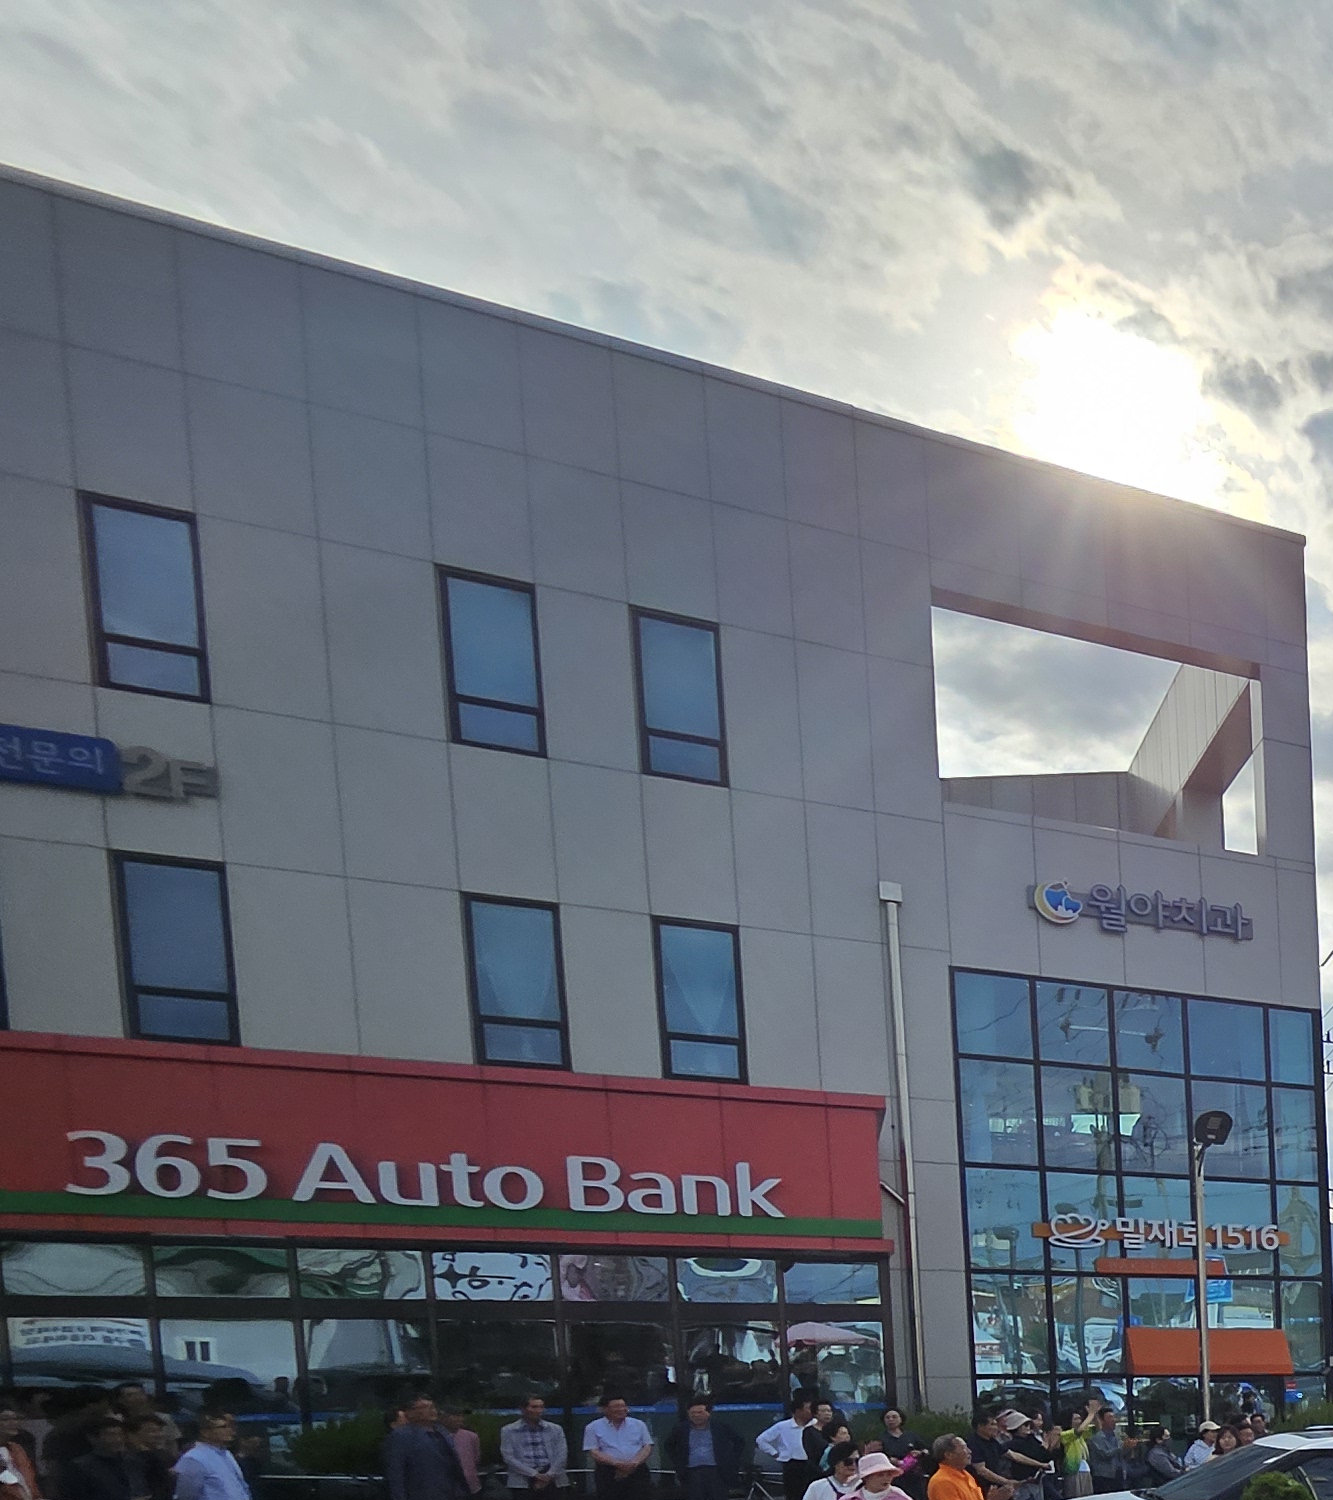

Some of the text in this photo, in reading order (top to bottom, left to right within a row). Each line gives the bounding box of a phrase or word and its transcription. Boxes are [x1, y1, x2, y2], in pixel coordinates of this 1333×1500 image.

[1088, 883, 1249, 940] 월야치과
[65, 1129, 785, 1219] 365 Auto Bank
